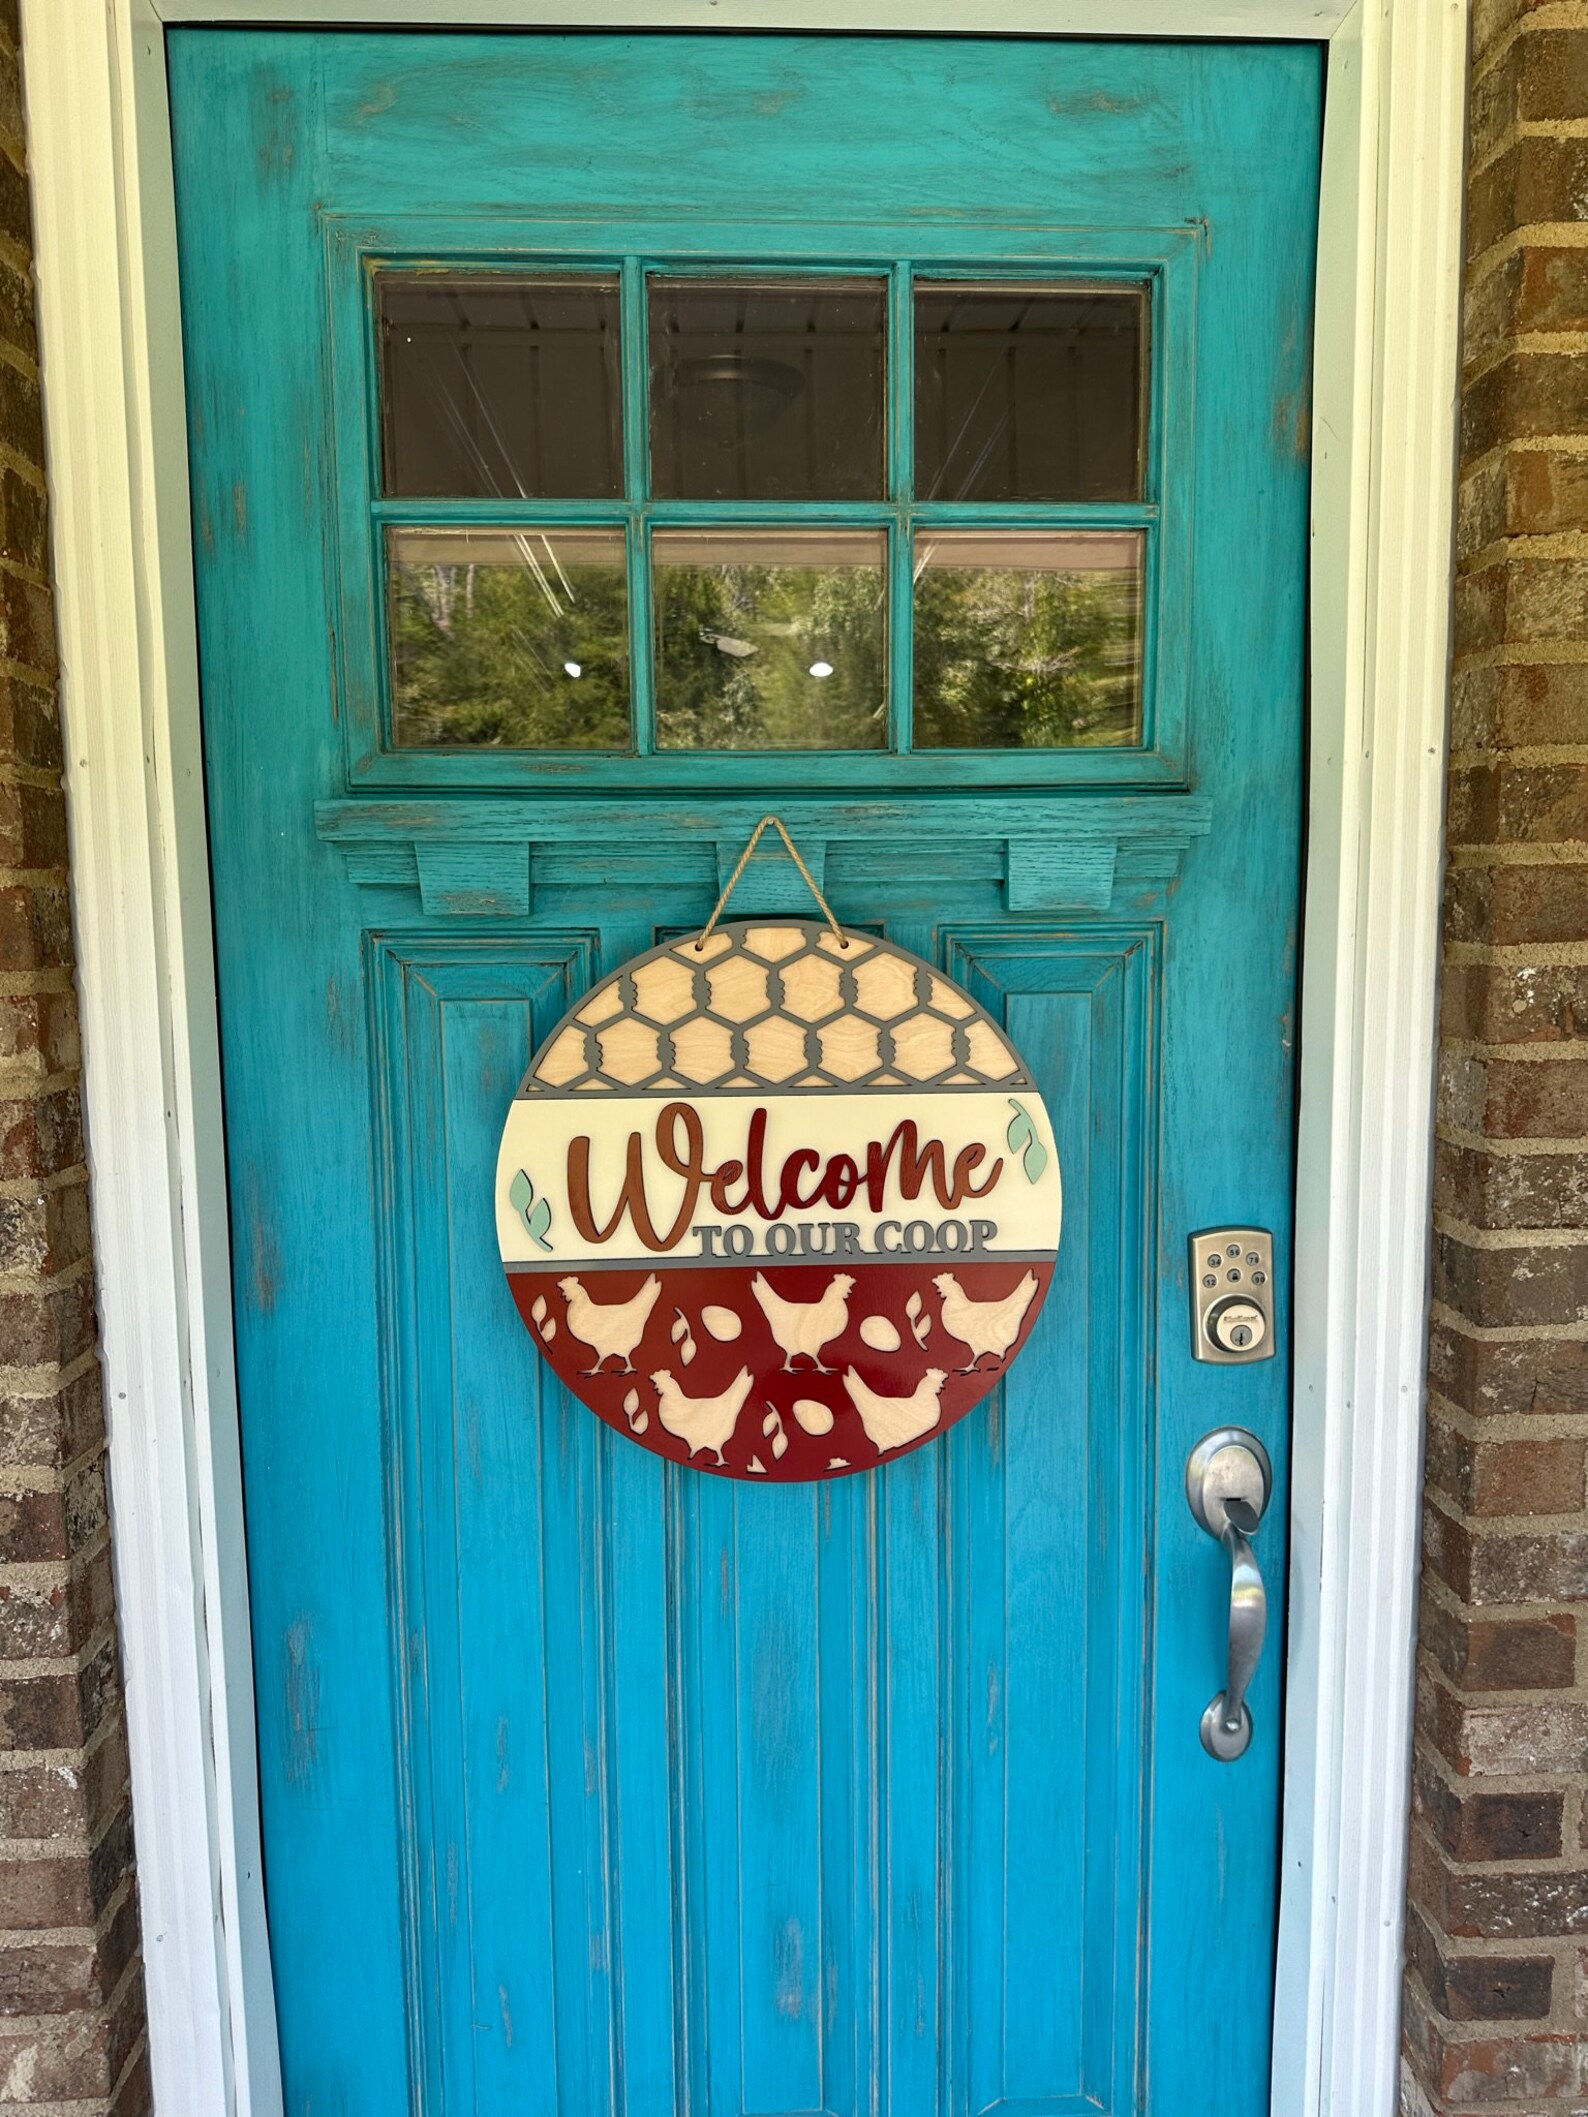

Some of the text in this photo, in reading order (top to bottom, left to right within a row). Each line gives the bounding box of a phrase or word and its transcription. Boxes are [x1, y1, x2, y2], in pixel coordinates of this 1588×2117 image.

[567, 1102, 1004, 1252] Welcome
[692, 1219, 998, 1258] TO OUR COOP
